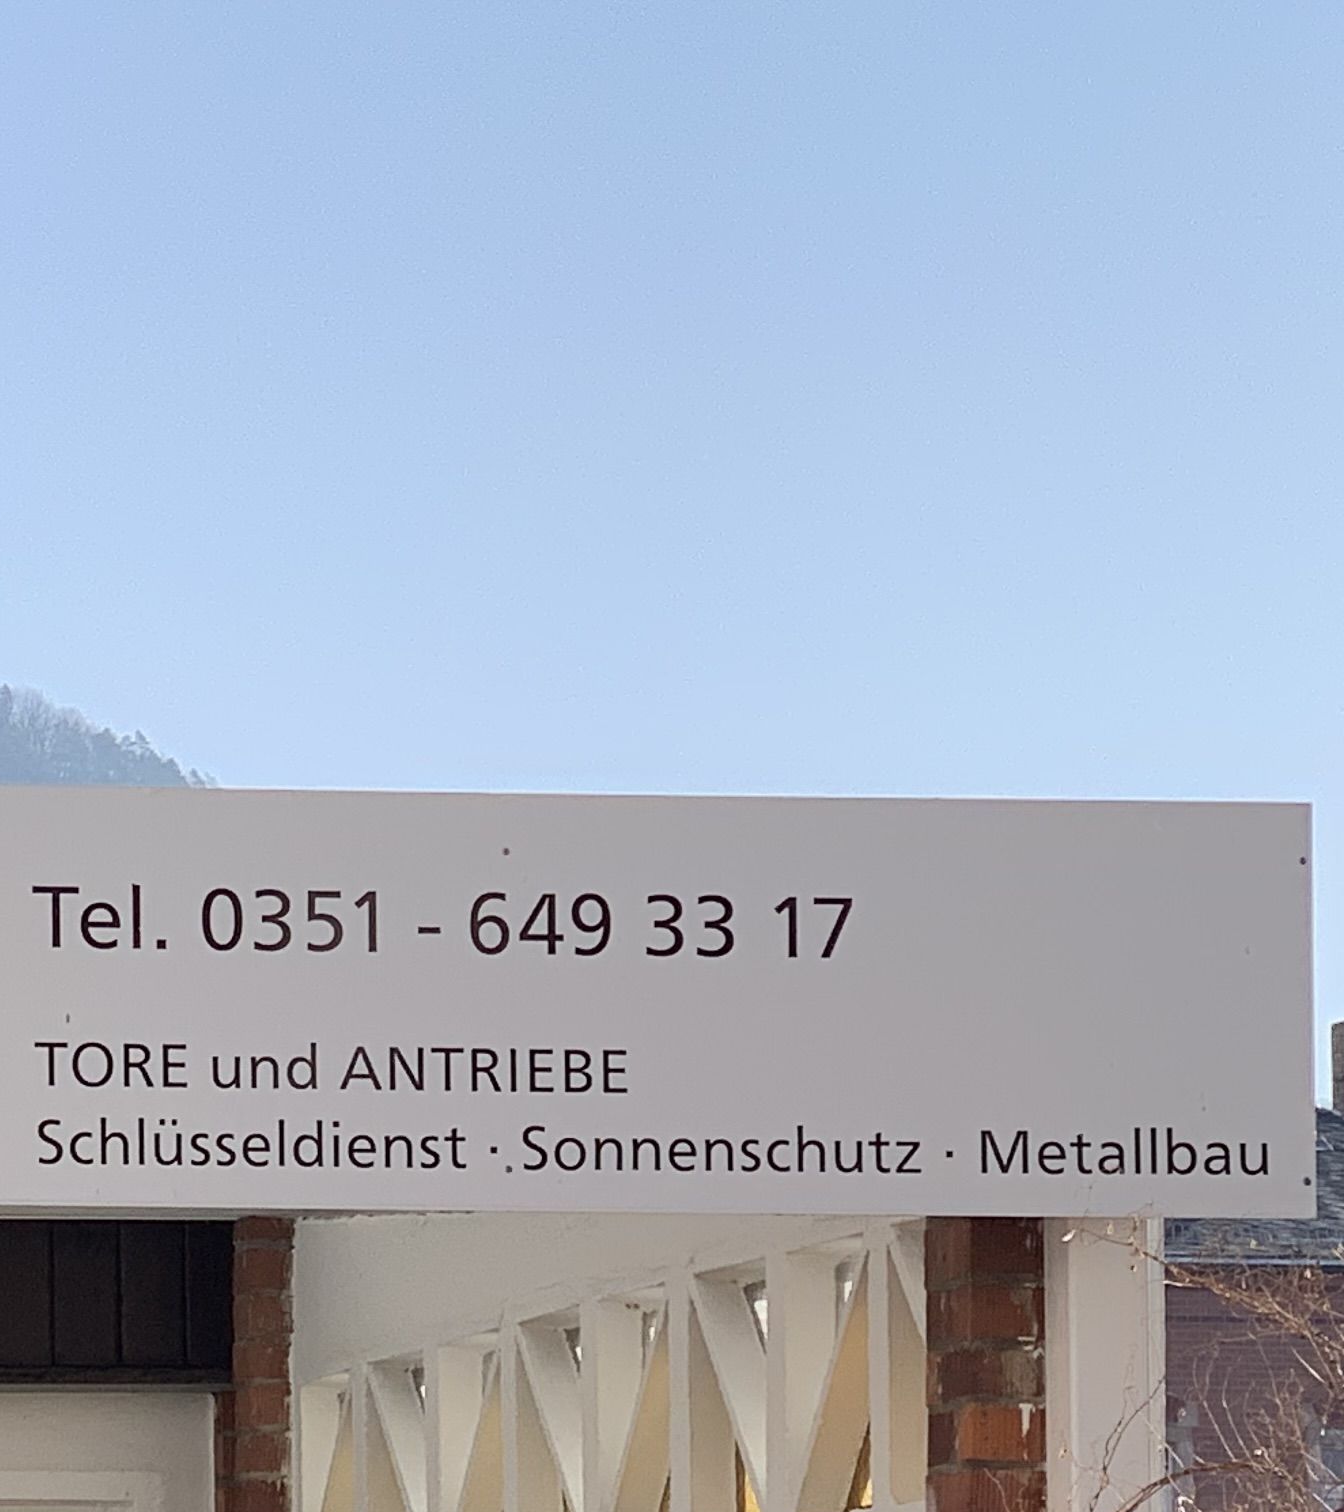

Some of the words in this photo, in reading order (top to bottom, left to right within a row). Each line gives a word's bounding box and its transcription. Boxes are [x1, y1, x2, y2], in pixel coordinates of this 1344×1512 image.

[32, 884, 168, 951] Tel.
[200, 888, 379, 954] 0351
[469, 891, 613, 956] 649
[645, 894, 736, 957] 33
[774, 896, 854, 959] 17
[34, 1042, 189, 1089] TORE
[212, 1042, 317, 1091] und
[340, 1045, 629, 1094] ANTRIEBE
[37, 1118, 467, 1170] Schlüsseldienst
[521, 1123, 922, 1174] Sonnenschutz
[980, 1127, 1270, 1177] Metallbau
